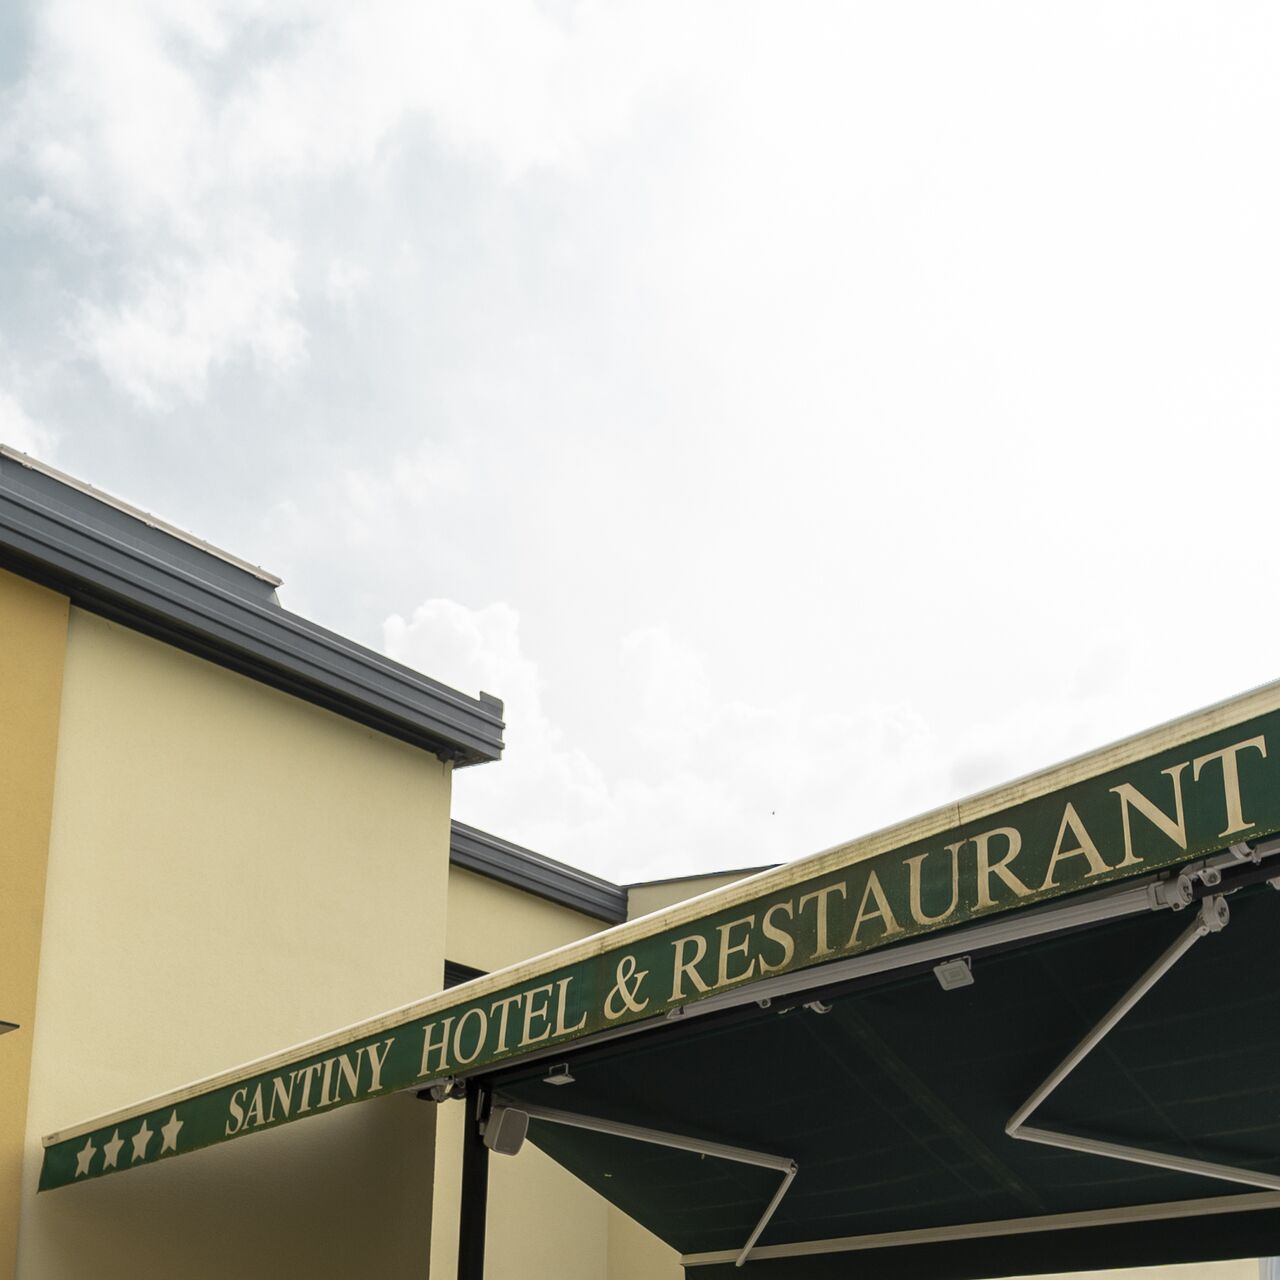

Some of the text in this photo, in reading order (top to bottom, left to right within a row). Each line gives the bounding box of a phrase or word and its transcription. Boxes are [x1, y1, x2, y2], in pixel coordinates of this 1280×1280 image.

[225, 734, 1268, 1137] SANTINY HOTEL & RESTAURANT
